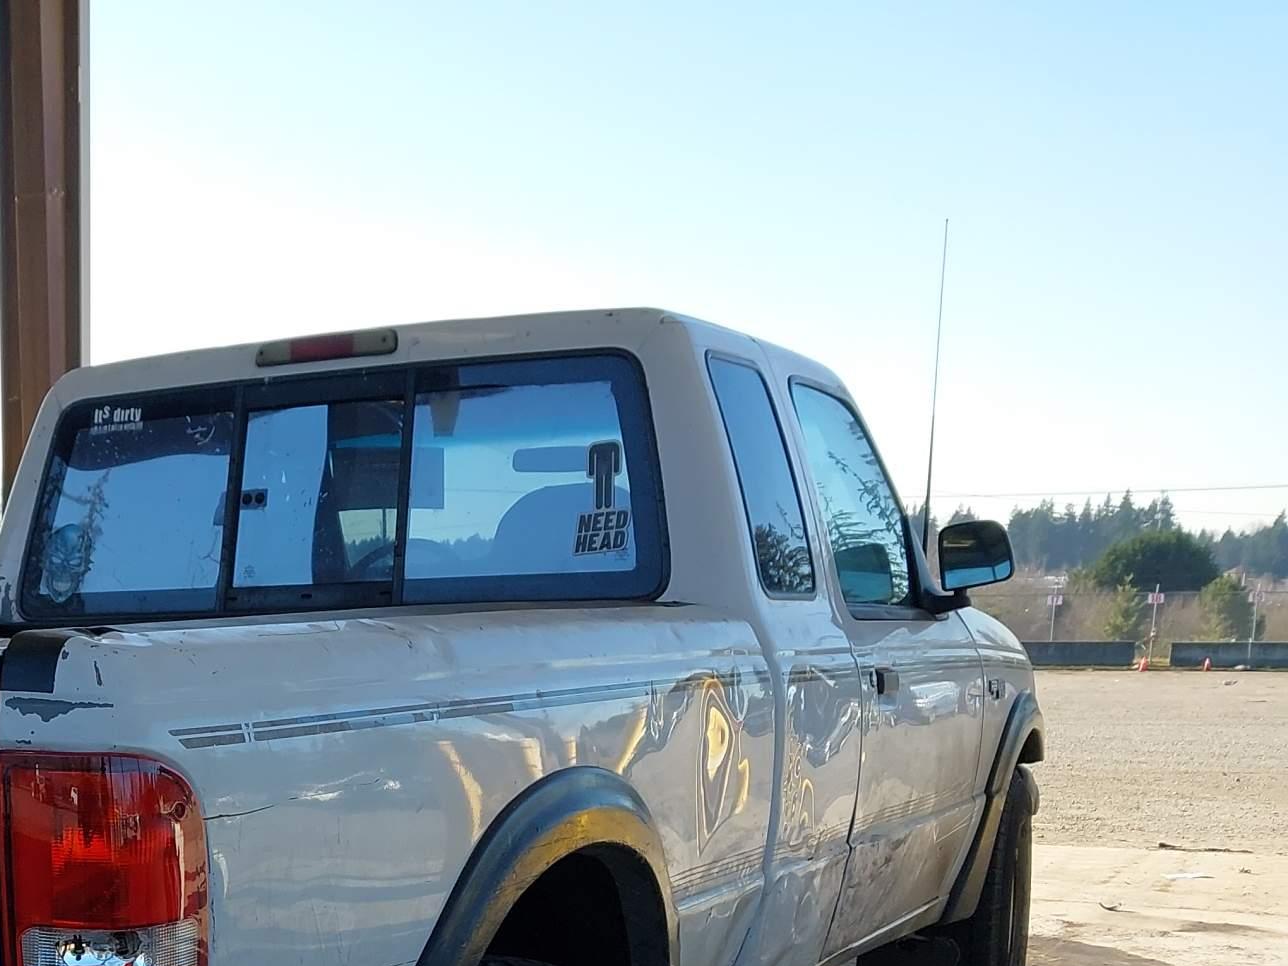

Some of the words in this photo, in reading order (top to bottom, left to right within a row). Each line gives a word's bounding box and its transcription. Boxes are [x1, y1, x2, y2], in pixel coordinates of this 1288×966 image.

[113, 407, 142, 422] dirty
[578, 510, 629, 533] NEED
[575, 530, 627, 553] HEAD
